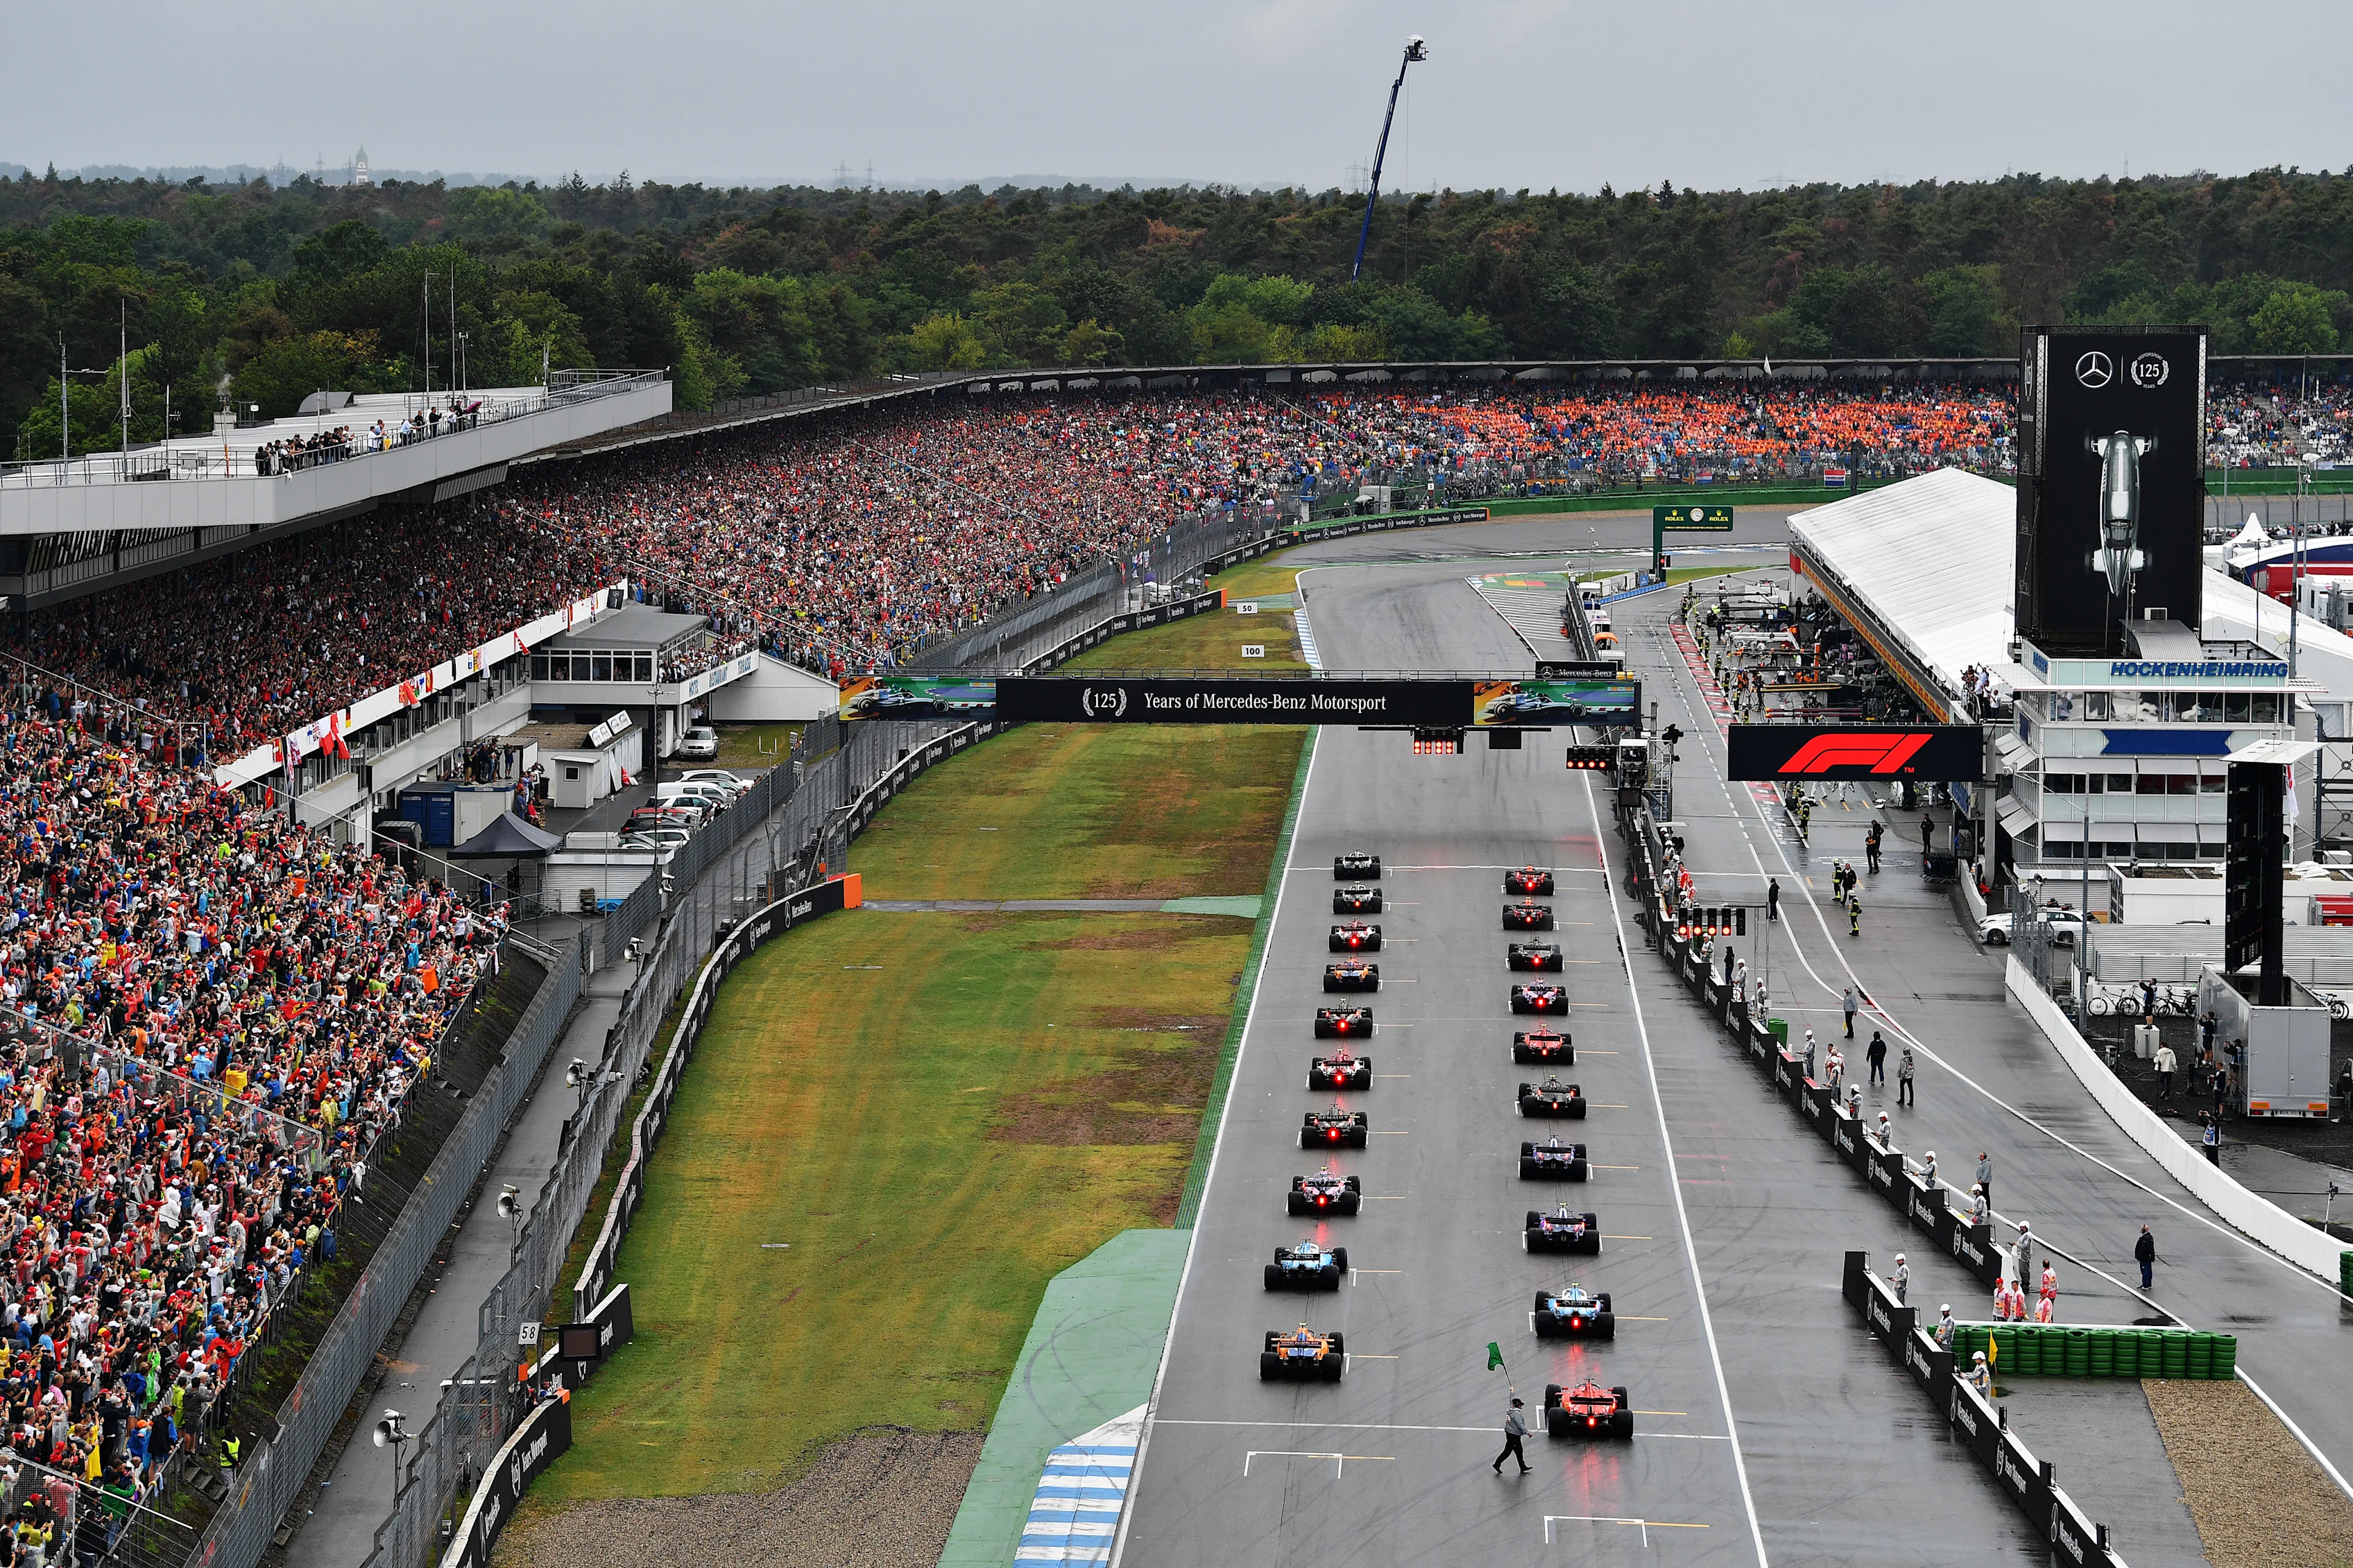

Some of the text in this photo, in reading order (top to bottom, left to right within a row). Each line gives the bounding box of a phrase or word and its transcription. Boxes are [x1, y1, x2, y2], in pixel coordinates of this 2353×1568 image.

[2137, 351, 2164, 361] MOTORSPORT
[2140, 364, 2159, 377] 125
[689, 655, 751, 698] HOTEL RESTAURANT TERRASSE
[2110, 662, 2288, 676] HOCKENHEIMRING
[1095, 693, 1386, 713] 125 Years of Mercedes-Benz Motorsport
[1778, 734, 1933, 773] F1
[792, 901, 812, 918] Mercedes-Benz
[1915, 1198, 1935, 1227] Mercedes-Benz
[1873, 1300, 1891, 1333] Mercedes-Benz
[522, 1327, 536, 1339] 58
[1957, 1399, 1976, 1436] Mercedes-Benz
[531, 1429, 547, 1463] Motorsport
[2059, 1520, 2083, 1564] Mercedes-Benz
